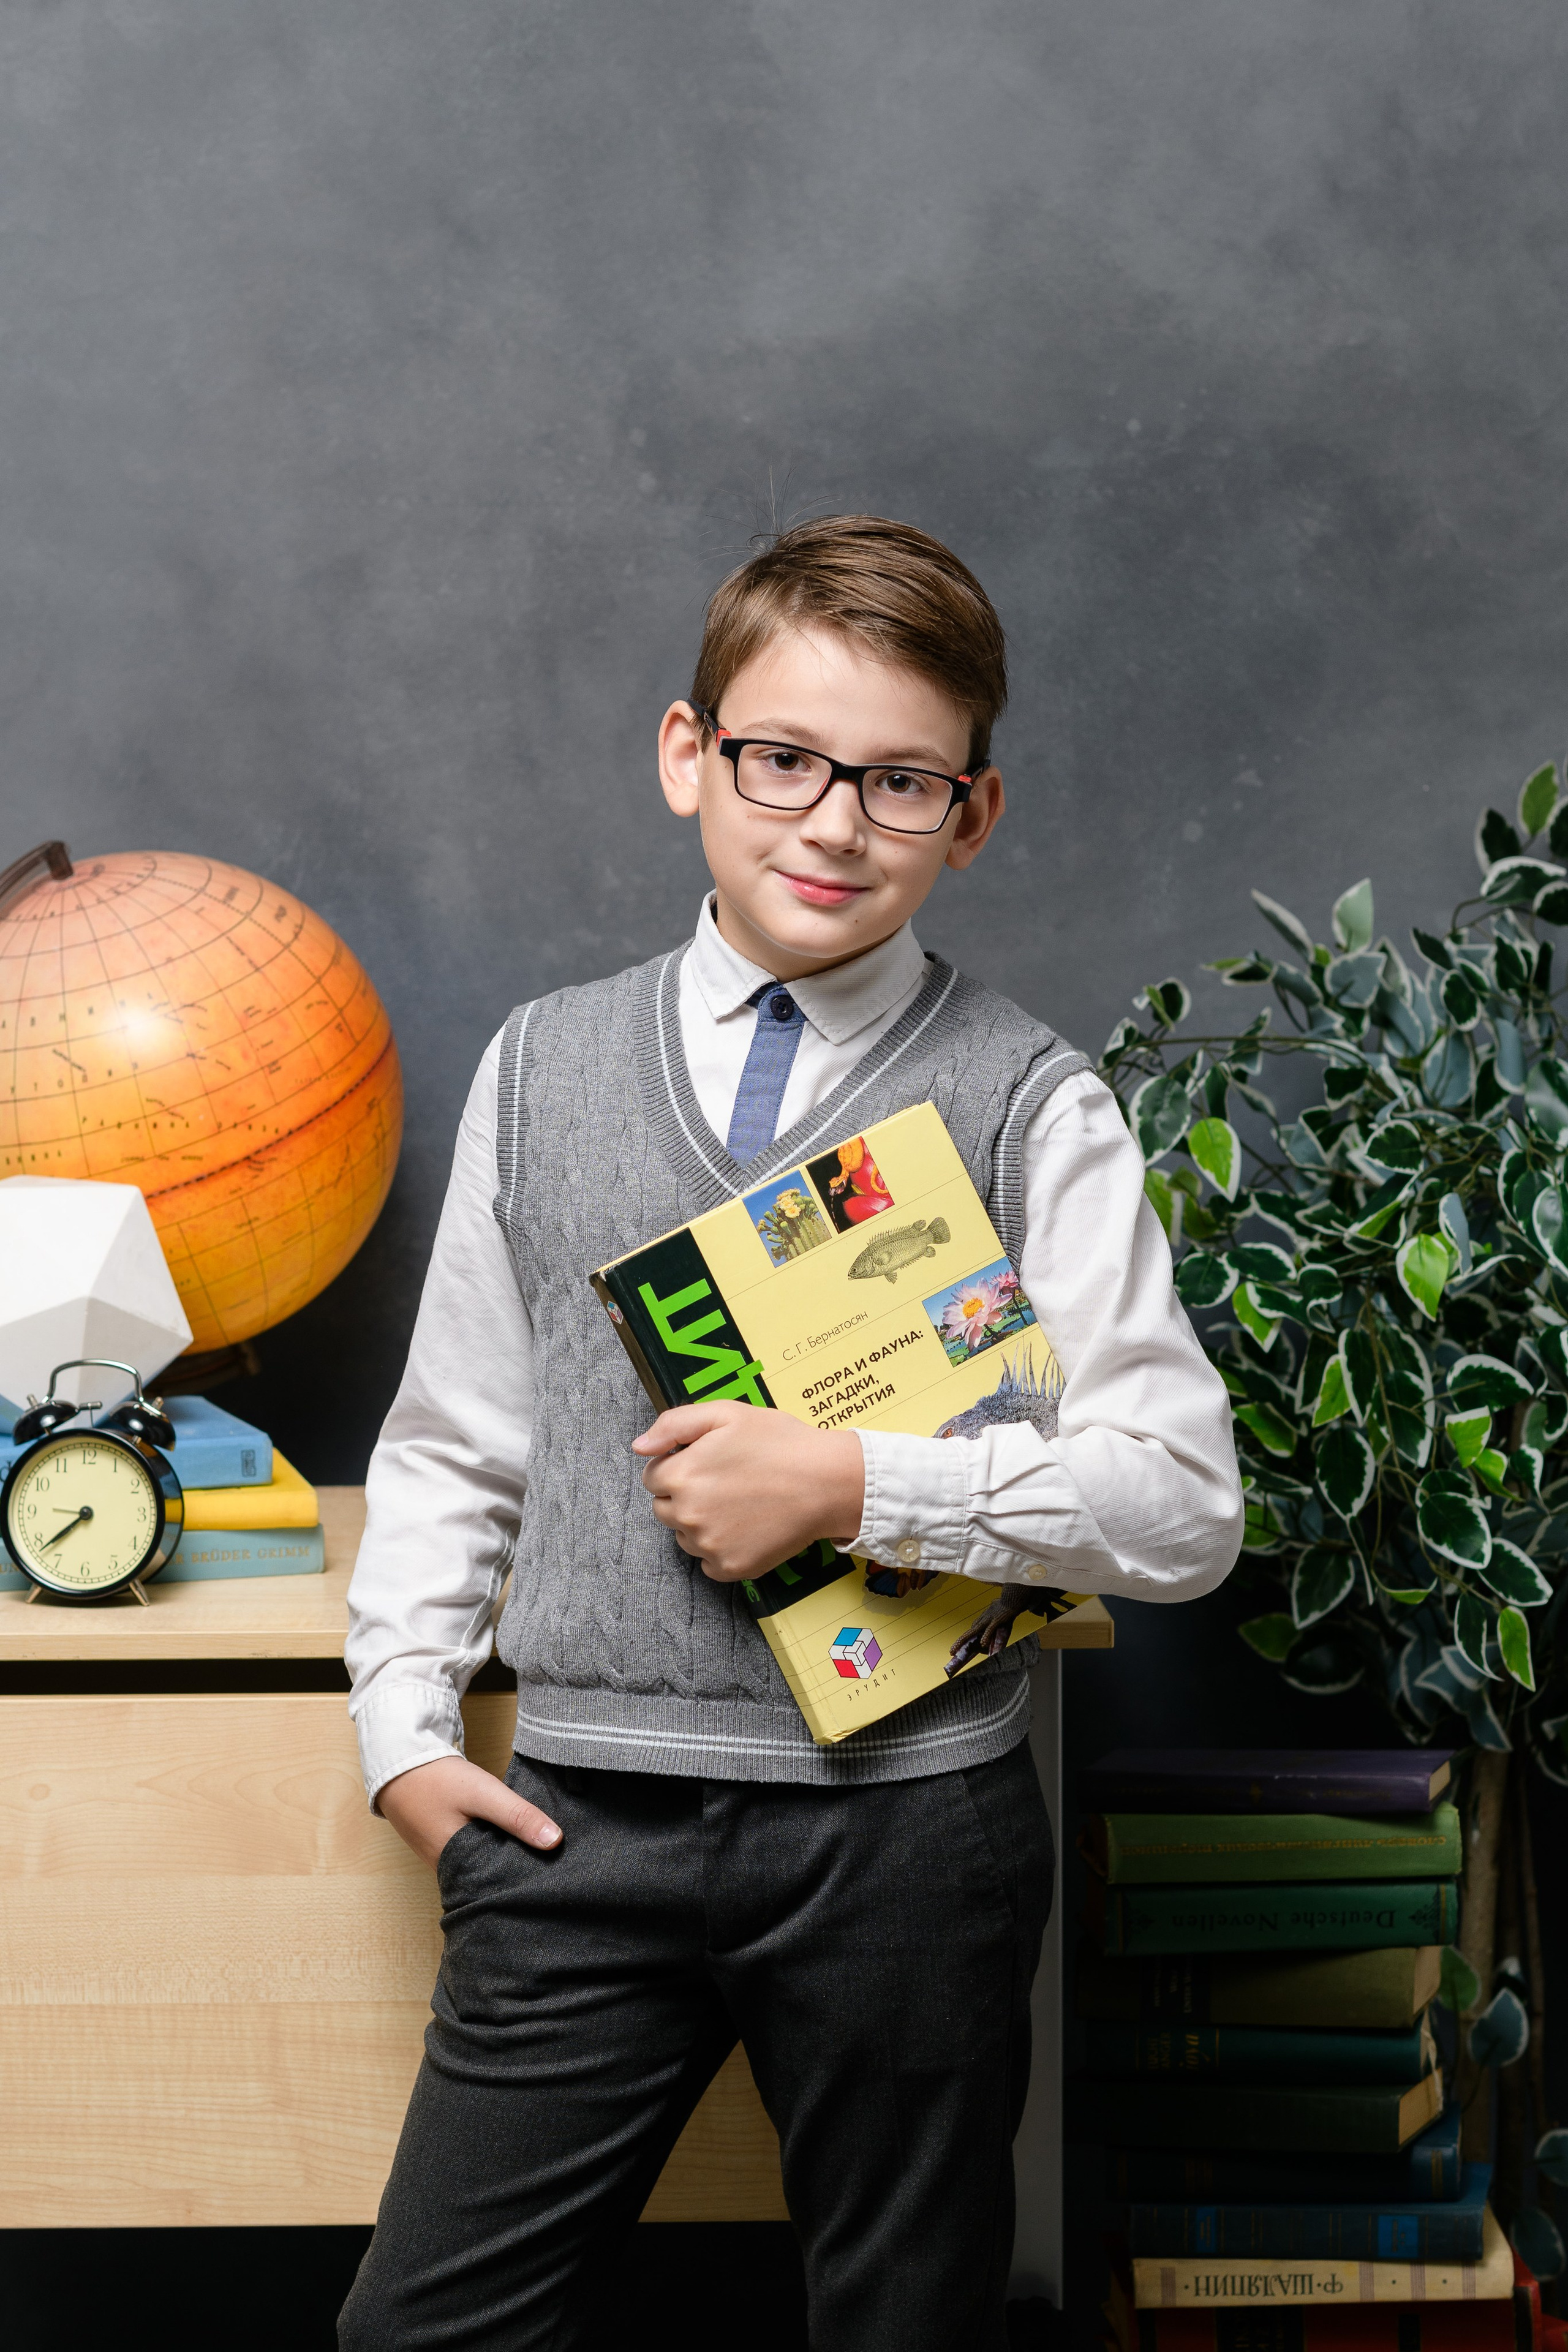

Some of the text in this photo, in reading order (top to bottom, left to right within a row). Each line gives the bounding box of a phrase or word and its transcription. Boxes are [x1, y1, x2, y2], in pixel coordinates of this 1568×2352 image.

[782, 1311, 869, 1361] С. Г. Бернатосян
[802, 1330, 924, 1400] ФЛОРА И ФАУНА:
[809, 1374, 880, 1417] ЗАГАДКИ,
[818, 1383, 896, 1430] ОТКРЫТИЯ
[82, 1449, 96, 1464] 12
[56, 1458, 67, 1472] 11
[36, 1477, 50, 1492] 10
[130, 1479, 140, 1493] 2
[28, 1504, 37, 1520] 9
[137, 1507, 146, 1522] 3
[34, 1532, 43, 1547] 8
[128, 1536, 138, 1550] 4
[54, 1554, 62, 1569] 7
[191, 1548, 252, 1563] BRÜDER
[258, 1545, 311, 1559] GRIMM
[80, 1562, 90, 1577] 6
[108, 1555, 118, 1570] 5
[847, 1668, 897, 1702] ЭРУДИТ
[1171, 1910, 1396, 1932] Deutsche Novellen
